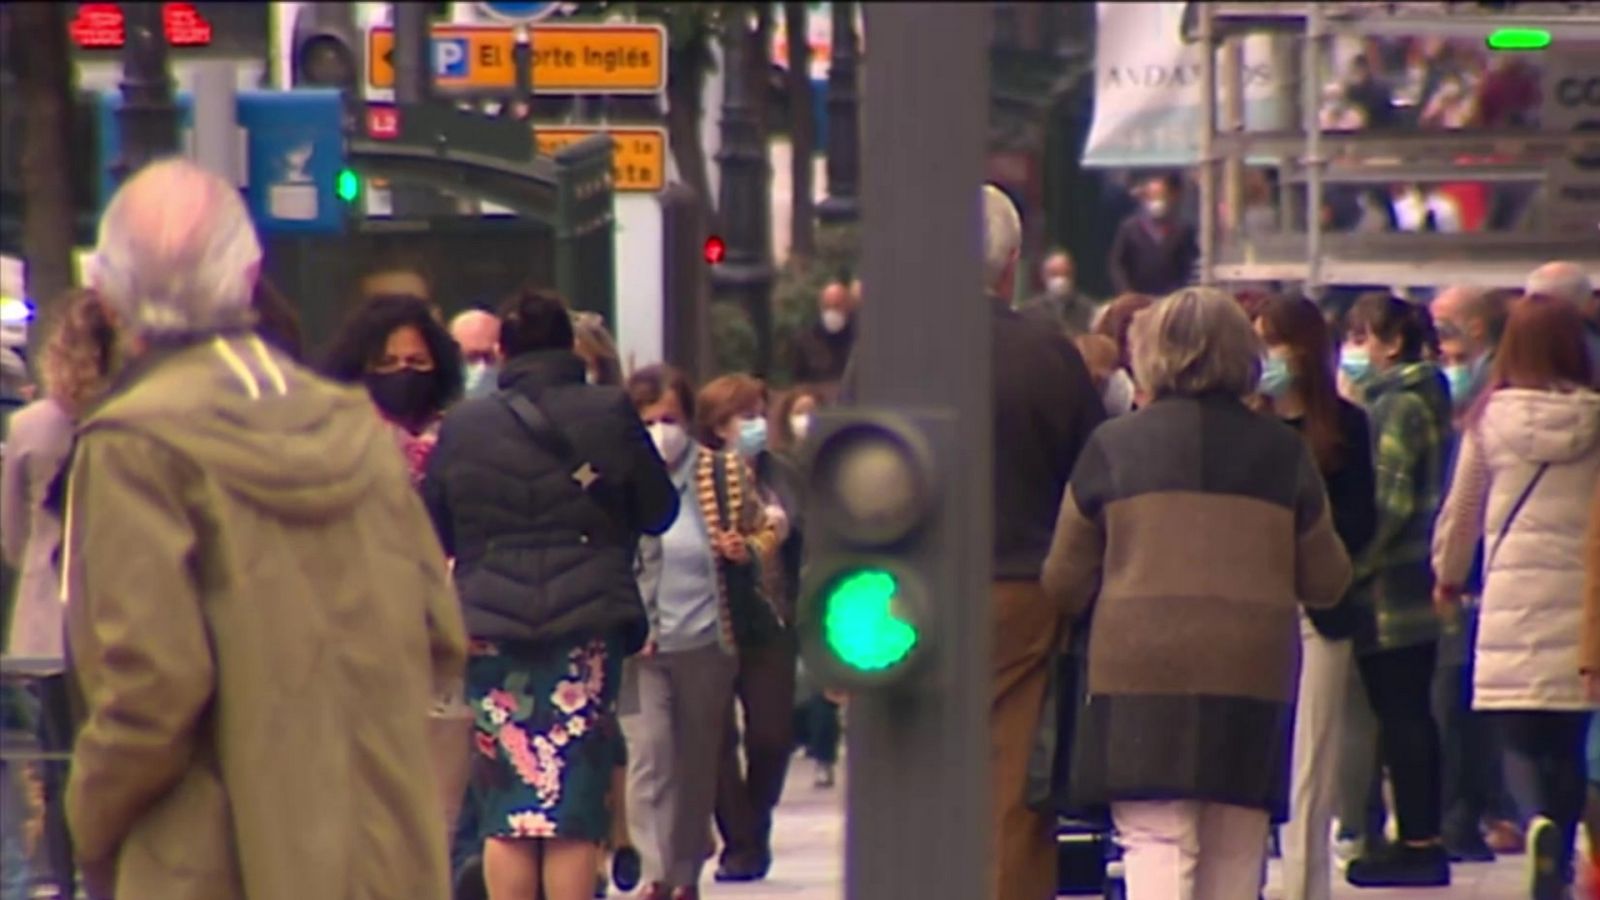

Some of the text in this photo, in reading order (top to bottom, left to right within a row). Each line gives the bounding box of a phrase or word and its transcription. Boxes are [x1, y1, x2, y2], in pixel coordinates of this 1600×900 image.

[480, 45, 501, 67] El
[511, 45, 575, 67] orte
[583, 44, 650, 72] Inglés
